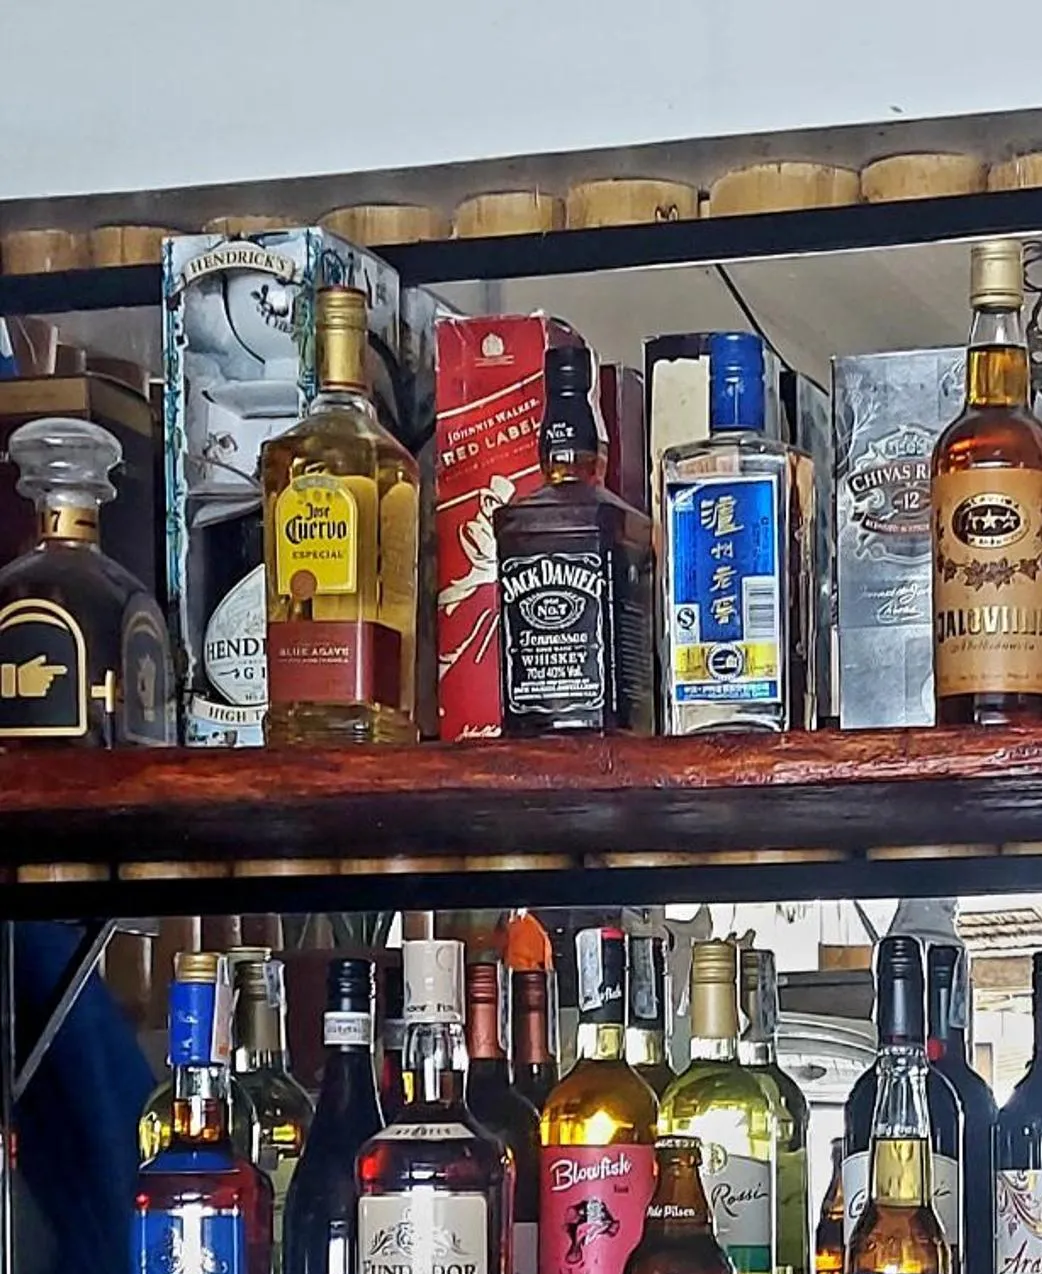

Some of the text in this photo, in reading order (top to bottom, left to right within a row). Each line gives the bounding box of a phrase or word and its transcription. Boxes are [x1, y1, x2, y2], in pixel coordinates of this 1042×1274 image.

[190, 249, 289, 274] HENDRICK'S
[441, 440, 480, 467] RED
[486, 416, 542, 450] LABEL
[851, 464, 911, 492] CHIVAS
[285, 516, 347, 545] Cuervo
[501, 568, 542, 603] JACK
[519, 630, 589, 647] Tennessee
[521, 651, 588, 666] WHISKEY
[549, 1152, 633, 1191] Blowfish
